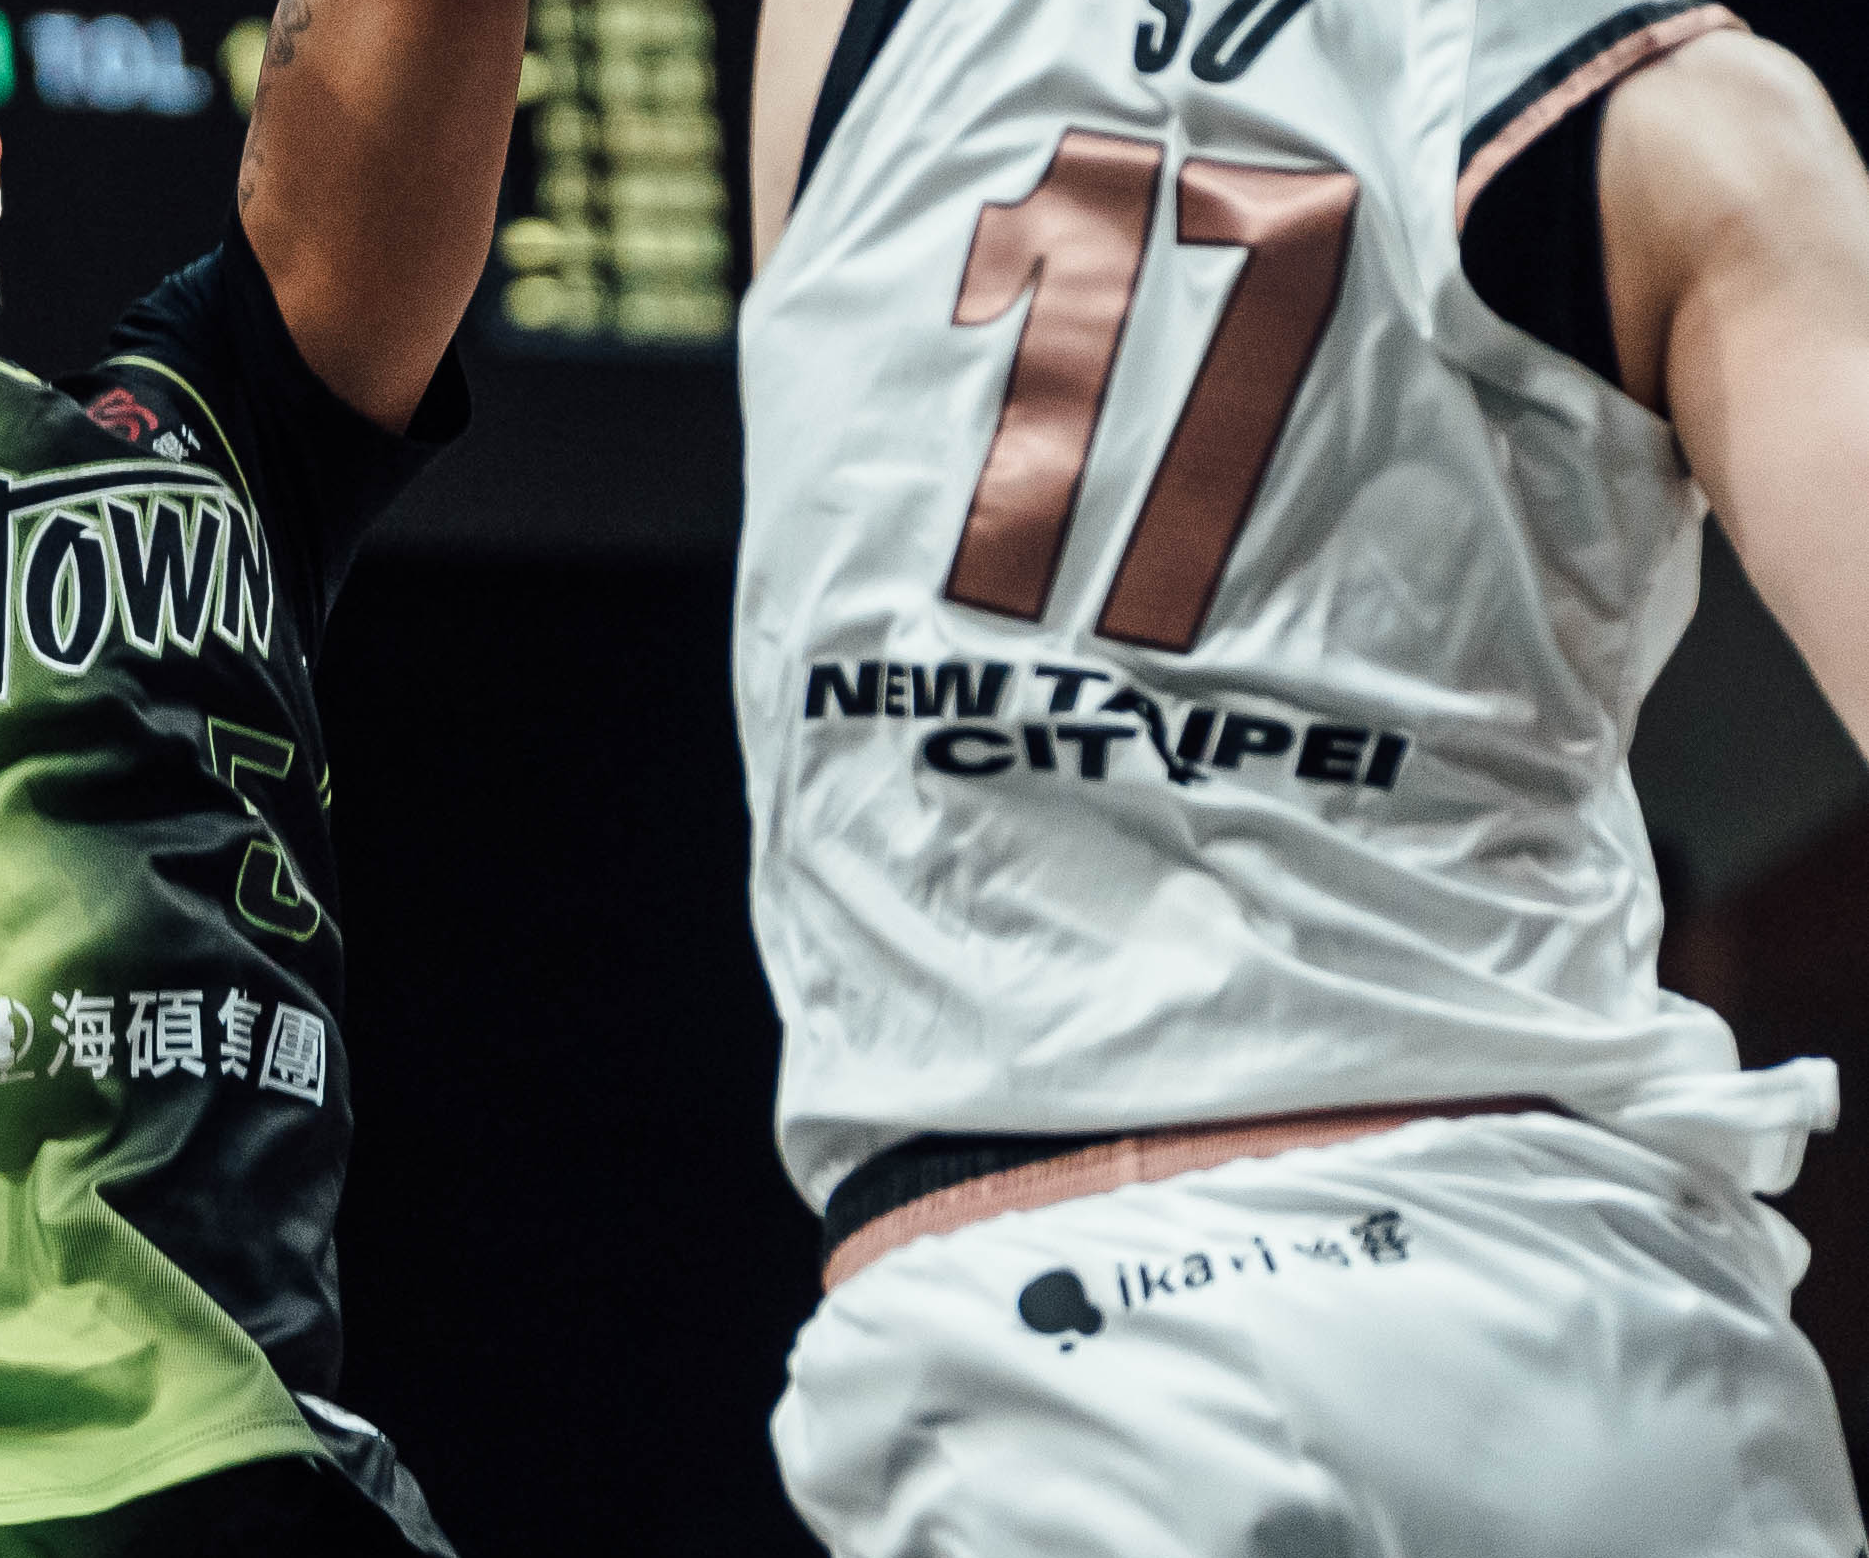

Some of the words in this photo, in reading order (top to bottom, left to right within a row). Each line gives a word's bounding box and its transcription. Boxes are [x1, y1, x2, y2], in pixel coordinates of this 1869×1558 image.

[944, 125, 1360, 655] 17
[804, 659, 1013, 719] NEW
[1035, 664, 1409, 790] TAIPEI
